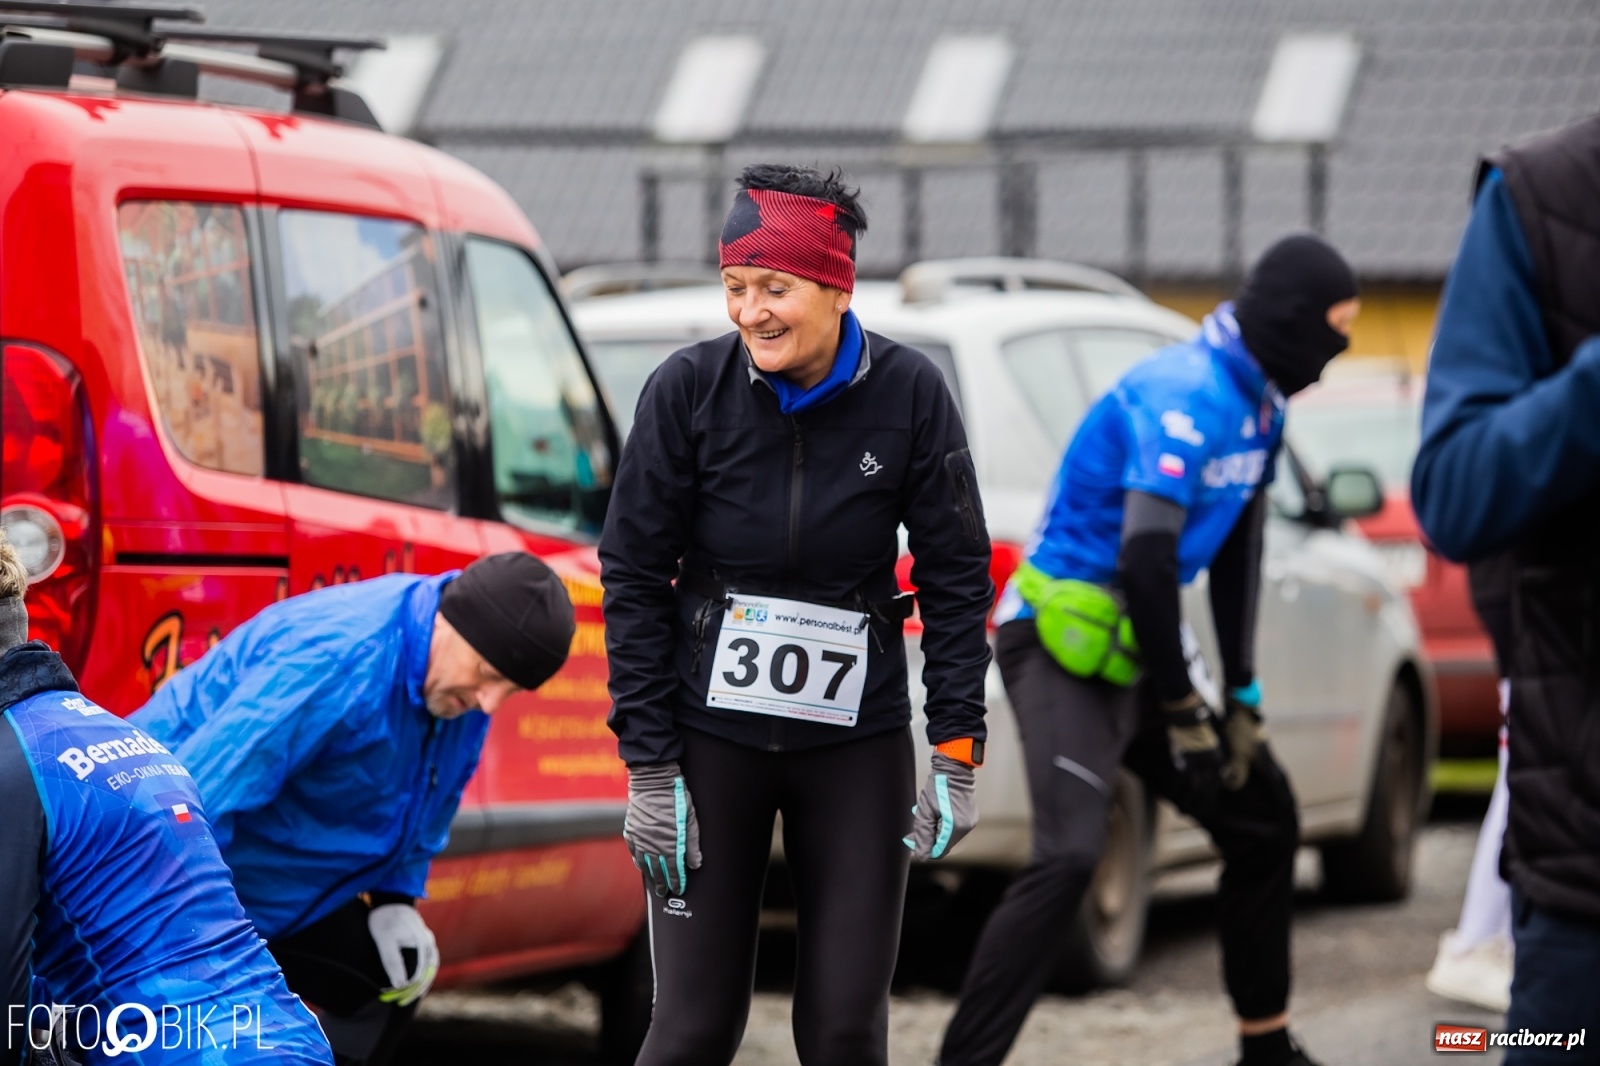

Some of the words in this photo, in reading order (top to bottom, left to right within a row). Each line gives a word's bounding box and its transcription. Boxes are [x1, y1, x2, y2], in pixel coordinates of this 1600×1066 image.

[723, 637, 857, 701] 307
[57, 730, 172, 780] Bernade
[107, 764, 164, 791] EKO-OKNA
